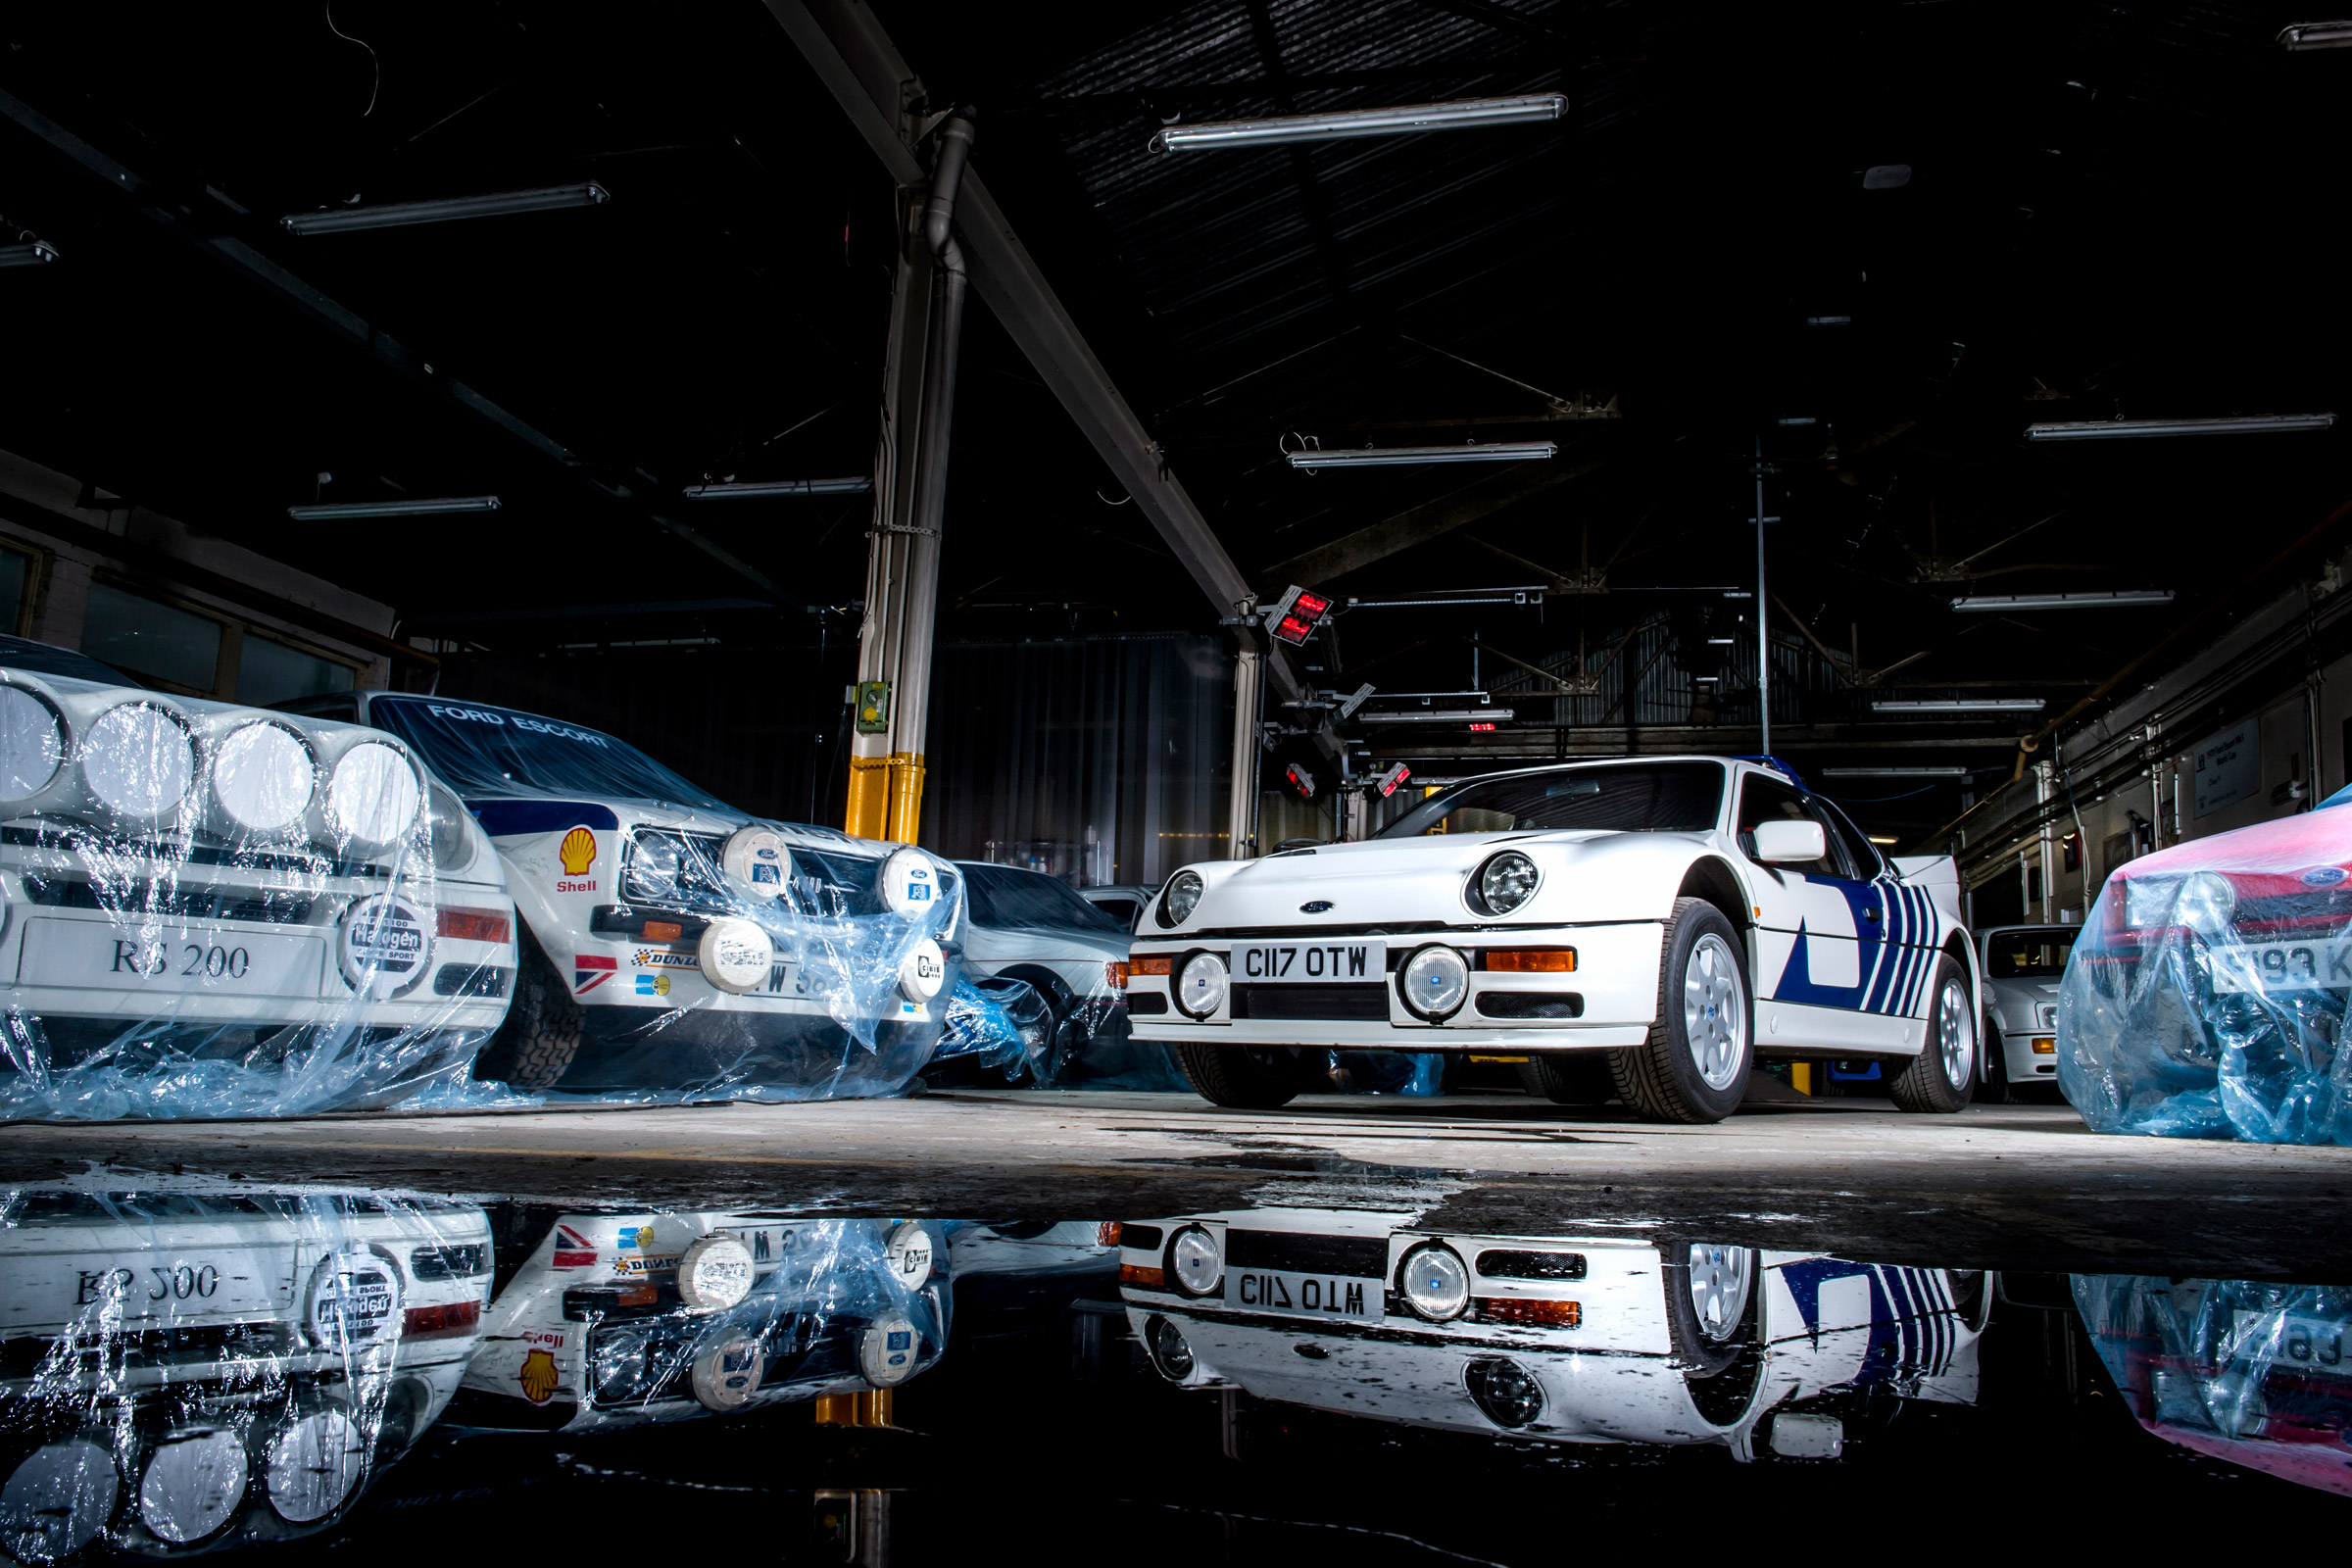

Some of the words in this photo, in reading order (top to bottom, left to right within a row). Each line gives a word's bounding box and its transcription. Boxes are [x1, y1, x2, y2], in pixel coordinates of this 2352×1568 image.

[427, 705, 504, 725] FORD
[511, 716, 609, 749] ESCORT
[557, 880, 597, 893] Shell
[354, 923, 418, 949] Haogen
[110, 939, 168, 975] RS
[180, 944, 250, 979] 200
[388, 951, 416, 959] SPORT
[1246, 948, 1298, 977] C117
[1306, 947, 1367, 976] OTW
